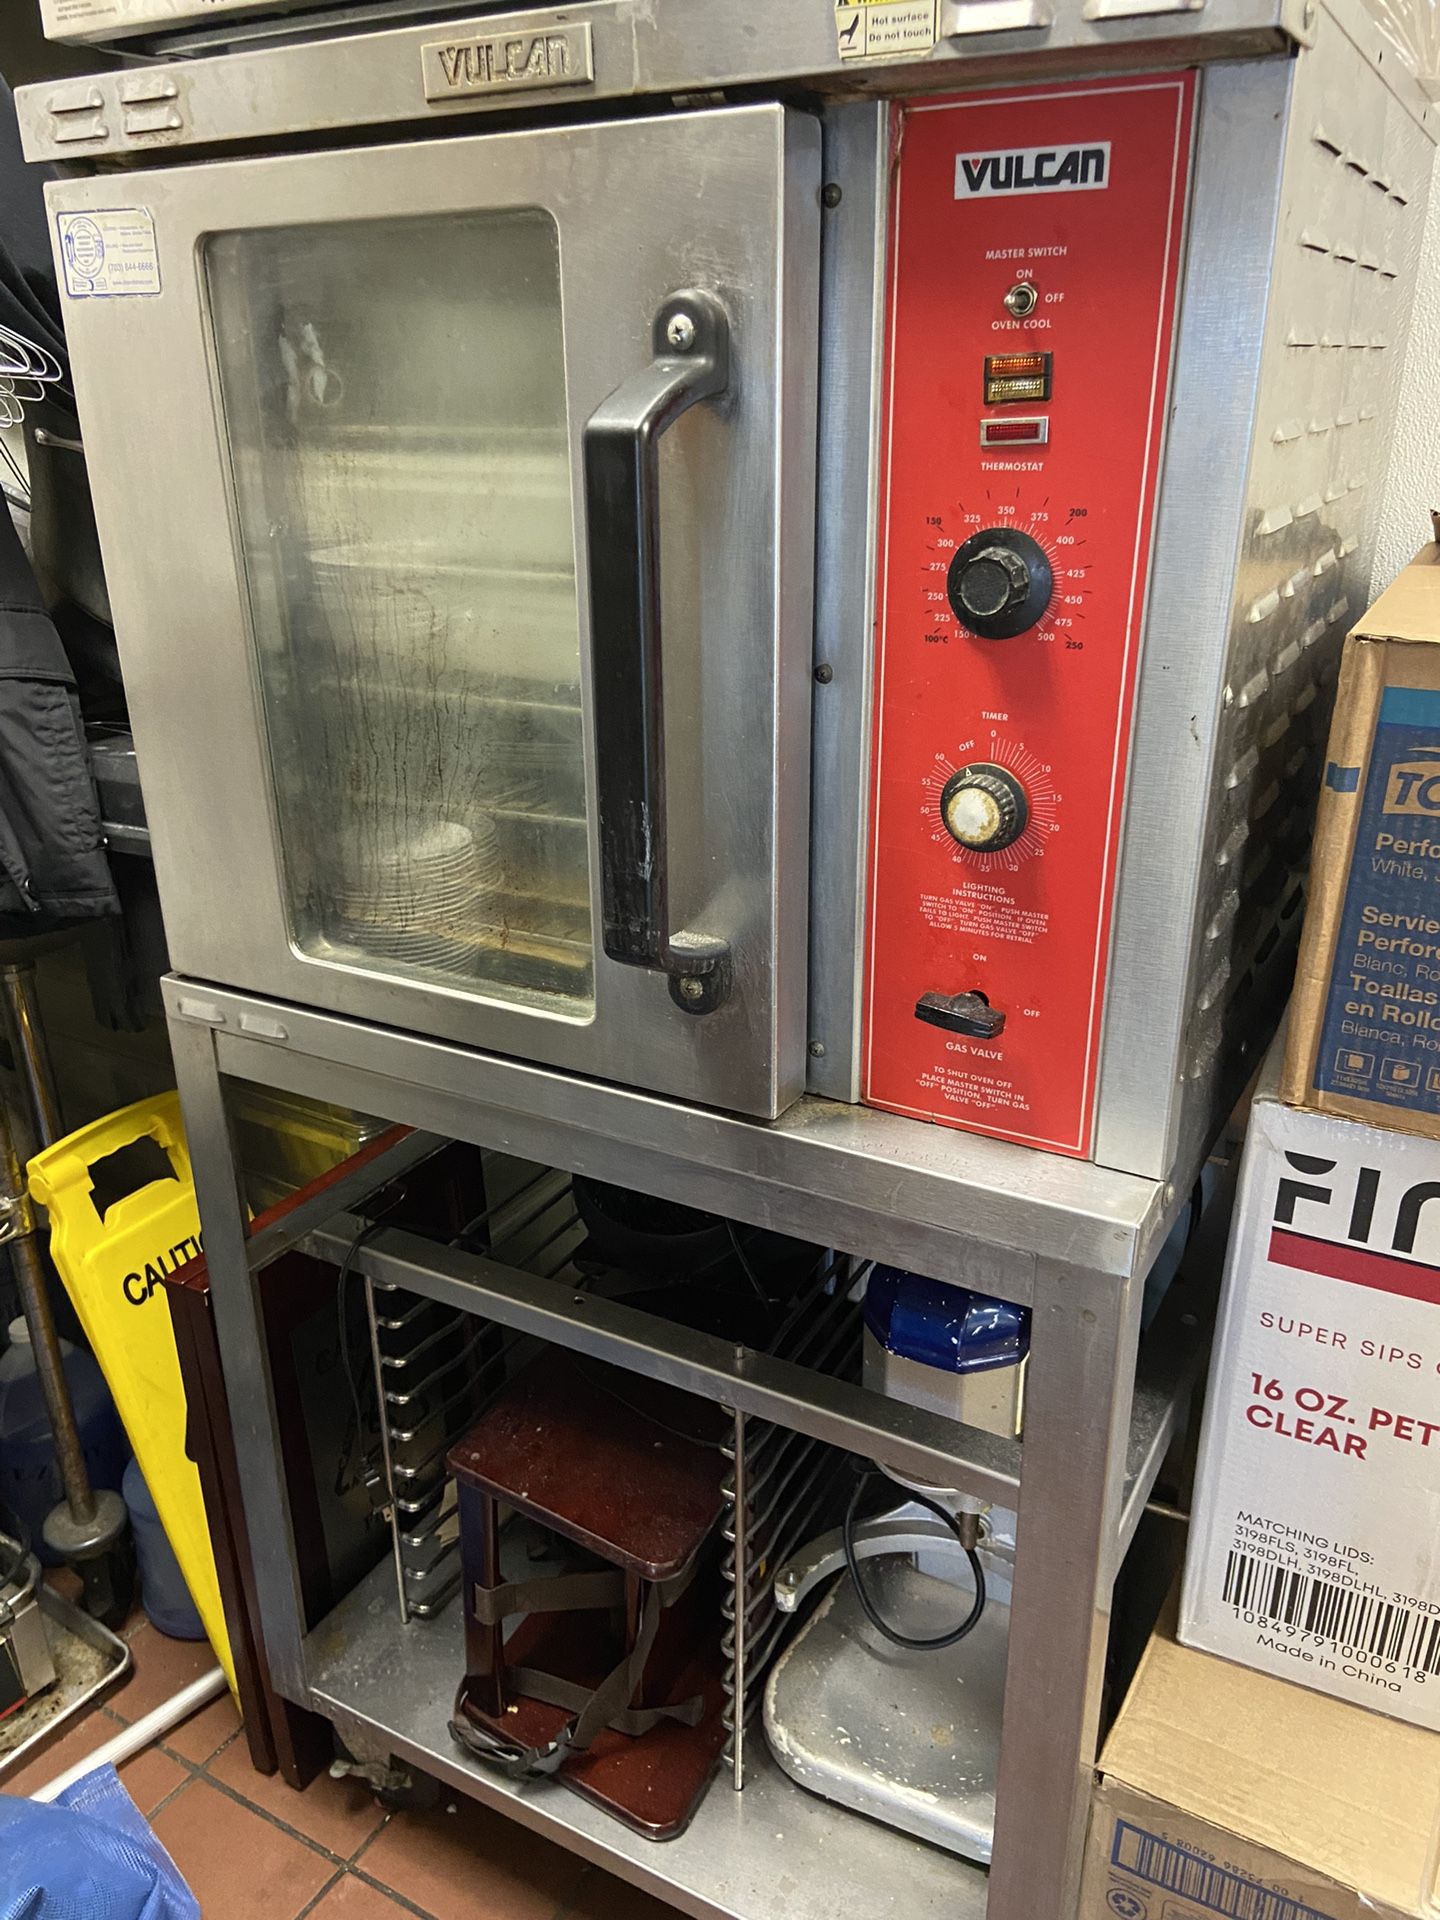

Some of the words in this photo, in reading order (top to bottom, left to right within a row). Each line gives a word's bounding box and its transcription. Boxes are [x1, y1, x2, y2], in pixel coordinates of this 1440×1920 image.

[872, 17, 888, 26] Hot
[892, 12, 929, 23] surface
[869, 33, 881, 42] Do
[884, 31, 900, 40] not
[903, 27, 932, 38] touch
[438, 34, 572, 86] VULCAN
[962, 149, 1105, 191] VULCAN
[985, 249, 1024, 260] MASTER
[1028, 246, 1068, 258] SWITCH
[1016, 269, 1033, 279] ON
[1045, 293, 1064, 303] OFF
[991, 320, 1020, 330] OVEN
[1024, 319, 1052, 329] COOL
[981, 462, 1044, 471] THERMOSTAT
[998, 506, 1015, 515] 350
[1069, 509, 1088, 518] 200
[926, 517, 942, 525] 150
[964, 515, 981, 524] 325
[1031, 513, 1049, 522] 375
[938, 540, 954, 548] 300
[1056, 536, 1074, 545] 400
[930, 563, 946, 572] 275
[1067, 569, 1085, 578] 425
[928, 592, 944, 600] 250
[1064, 596, 1082, 604] 450
[934, 614, 950, 622] 225
[1055, 618, 1072, 627] 475
[1038, 632, 1055, 642] 500
[1066, 642, 1084, 650] 250
[982, 712, 1008, 721] TIMER
[990, 730, 996, 738] 0
[959, 740, 975, 752] OFF
[1019, 743, 1025, 751] 5
[935, 753, 945, 761] 60
[1052, 794, 1062, 802] 15
[1050, 824, 1060, 832] 20
[931, 834, 941, 842] 45
[980, 864, 990, 872] 35
[1009, 864, 1018, 872] 30
[1372, 857, 1427, 882] White,
[963, 882, 1006, 895] LIGHTING
[952, 888, 1015, 905] INSTRUCTIONS
[920, 894, 938, 902] TURN
[939, 896, 954, 904] GAS
[955, 900, 975, 908] VALVE
[1001, 907, 1021, 916] PUSH
[1022, 911, 1049, 920] MASTER
[922, 900, 946, 910] SWITCH
[948, 904, 958, 912] TO
[1026, 918, 1046, 926] OVEN
[920, 906, 936, 915] FAILS
[974, 916, 992, 924] PUSH
[993, 918, 1020, 929] MASTER
[1022, 924, 1048, 934] SWITCH
[1361, 906, 1440, 934] Servie
[929, 921, 952, 930] ALLOW
[959, 926, 990, 936] MINUTES
[990, 932, 1005, 940] FOR
[960, 920, 978, 928] TURN
[980, 923, 994, 931] GAS
[996, 926, 1020, 935] VALVE
[1358, 929, 1440, 960] Perfor
[972, 953, 987, 962] ON
[1353, 954, 1408, 978] Blanc,
[1350, 973, 1438, 1005] Toallas
[1024, 1008, 1040, 1018] OFF
[1344, 1000, 1374, 1018] en
[1342, 1020, 1405, 1047] Blanca,
[1412, 1034, 1440, 1052] Ro
[946, 1042, 968, 1054] GAS
[970, 1046, 1003, 1061] VALVE
[934, 1066, 945, 1074] TO
[947, 1069, 968, 1079] SHUT
[970, 1074, 994, 1085] OVEN
[996, 1080, 1012, 1089] OFF
[922, 1073, 945, 1084] PLACE
[947, 1077, 978, 1091] MASTER
[981, 1086, 1012, 1099] SWITCH
[1014, 1094, 1024, 1102] IN
[916, 1079, 938, 1088] "OFF"
[988, 1096, 1010, 1106] TURN
[1012, 1101, 1030, 1111] GAS
[944, 1094, 968, 1104] VALVE
[123, 1232, 204, 1306] CAUTI
[1260, 1312, 1348, 1350] SUPER
[1360, 1340, 1422, 1369] SIPS
[1250, 1372, 1284, 1402] 16
[1295, 1387, 1356, 1424] OZ.
[1368, 1407, 1440, 1447] PET
[1246, 1404, 1368, 1461] CLEAR
[1236, 1510, 1329, 1549] MATCHING
[1334, 1542, 1375, 1566] LIDS:
[1235, 1524, 1298, 1556] 3198FLS,
[1304, 1547, 1359, 1576] 3198FL,
[1232, 1538, 1302, 1572] 3198DLH,
[1307, 1563, 1388, 1600] 3198DLHL,
[1232, 1607, 1426, 1684] 10849791000618
[1256, 1634, 1314, 1662] Made
[1320, 1655, 1336, 1671] in
[1342, 1664, 1402, 1692] China
